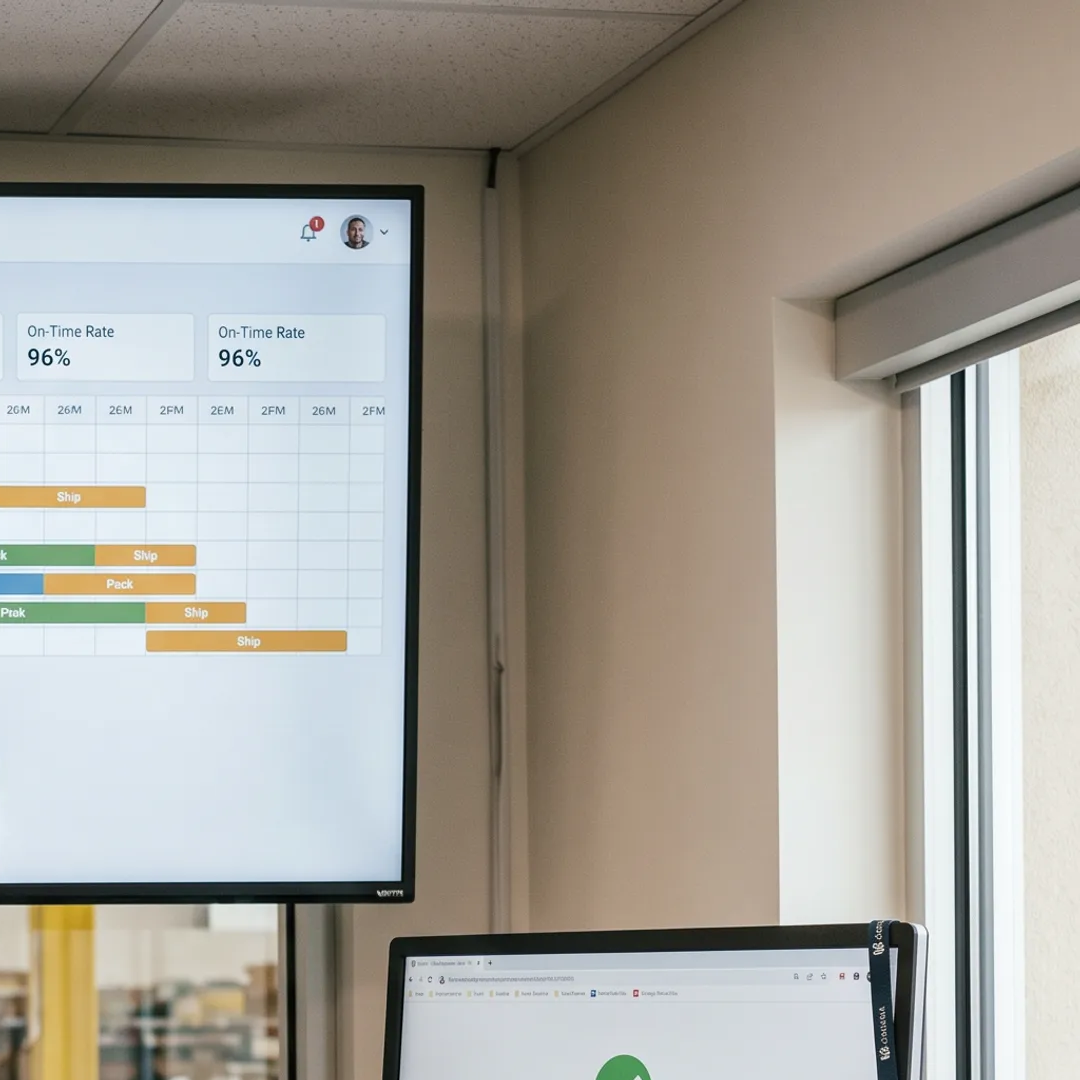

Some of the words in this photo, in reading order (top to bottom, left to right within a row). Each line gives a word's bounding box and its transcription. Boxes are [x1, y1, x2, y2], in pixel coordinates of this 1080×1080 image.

[28, 325, 81, 337] On-Time
[86, 325, 114, 337] Rate
[219, 326, 272, 338] On-Time
[277, 326, 305, 338] Rate
[28, 348, 70, 366] 96%
[219, 349, 261, 367] 96%
[58, 406, 81, 414] 26M
[313, 406, 335, 415] 26M
[57, 492, 81, 504] Ship
[185, 607, 208, 620] Ship
[237, 636, 260, 648] Ship
